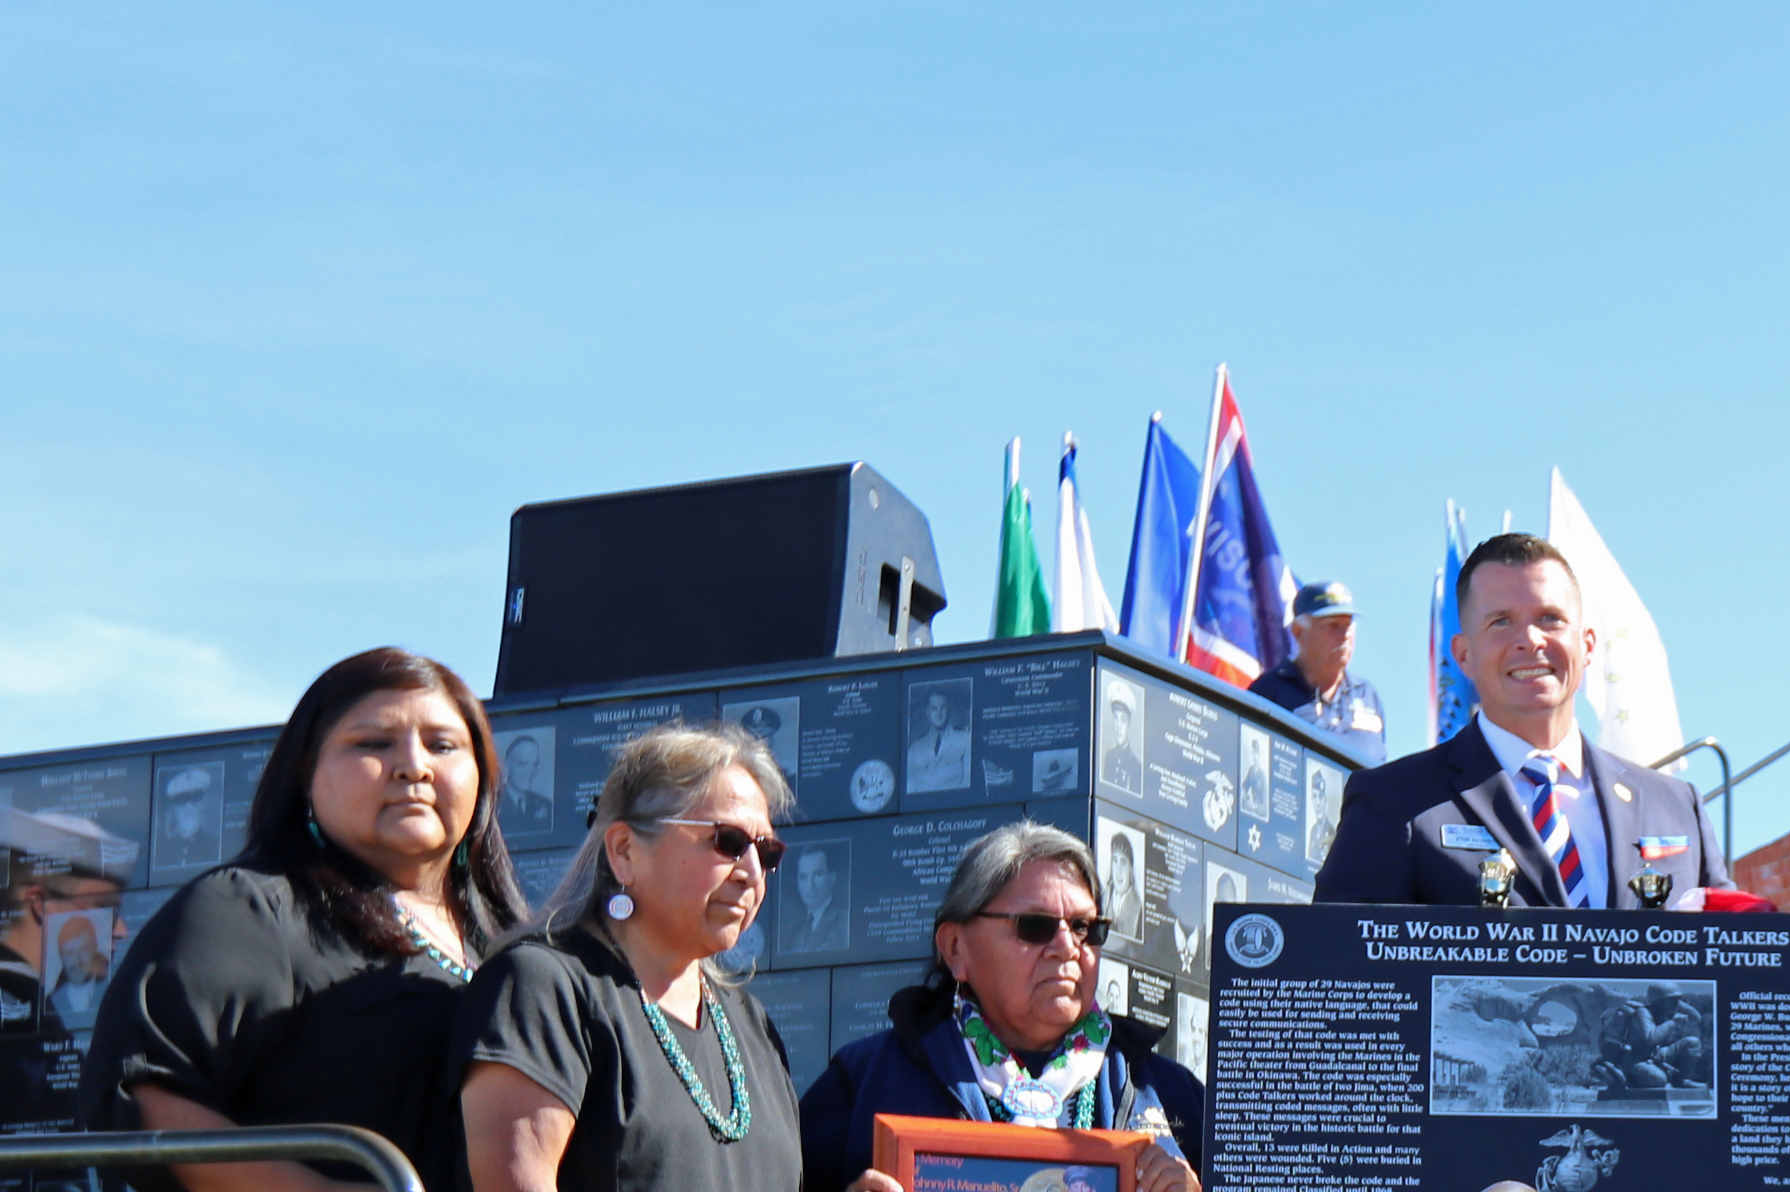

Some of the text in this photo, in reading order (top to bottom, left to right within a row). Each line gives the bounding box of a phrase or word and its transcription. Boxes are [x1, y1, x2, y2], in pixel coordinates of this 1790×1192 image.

[985, 667, 1016, 676] WILLIAM
[1053, 661, 1080, 670] HALSEY
[594, 710, 630, 723] WILLIAM
[640, 706, 670, 718] HALSEY
[893, 826, 924, 836] GEORGE
[928, 836, 951, 845] Colonel
[913, 868, 935, 876] African
[920, 876, 938, 885] World
[1357, 920, 1790, 945] THE WORLD WAR II NAVAJO CODE TALKERS
[1367, 943, 1509, 962] UNBREAKABLE
[1515, 945, 1568, 963] CODE
[1593, 947, 1698, 965] UNBROKEN
[1705, 948, 1782, 966] FUTURE
[1231, 978, 1249, 987] The
[1251, 978, 1278, 988] initial
[1280, 981, 1307, 990] group
[1309, 979, 1319, 988] of
[1320, 980, 1332, 988] 29
[1334, 980, 1371, 990] Navajos
[1220, 989, 1260, 998] recruited
[1263, 989, 1274, 1000] by
[1276, 989, 1292, 999] the
[1293, 990, 1326, 999] Marine
[1328, 990, 1354, 1001] Corps
[1355, 991, 1366, 1000] to
[1367, 991, 1403, 1002] develop
[1219, 998, 1418, 1011] code using their native language, that could
[1730, 1002, 1756, 1010] WWII
[1219, 1009, 1400, 1022] easily be used for sending and receiving
[1250, 1021, 1327, 1029] communications.
[921, 1154, 963, 1169] Memory
[914, 1178, 946, 1190] ohnny
